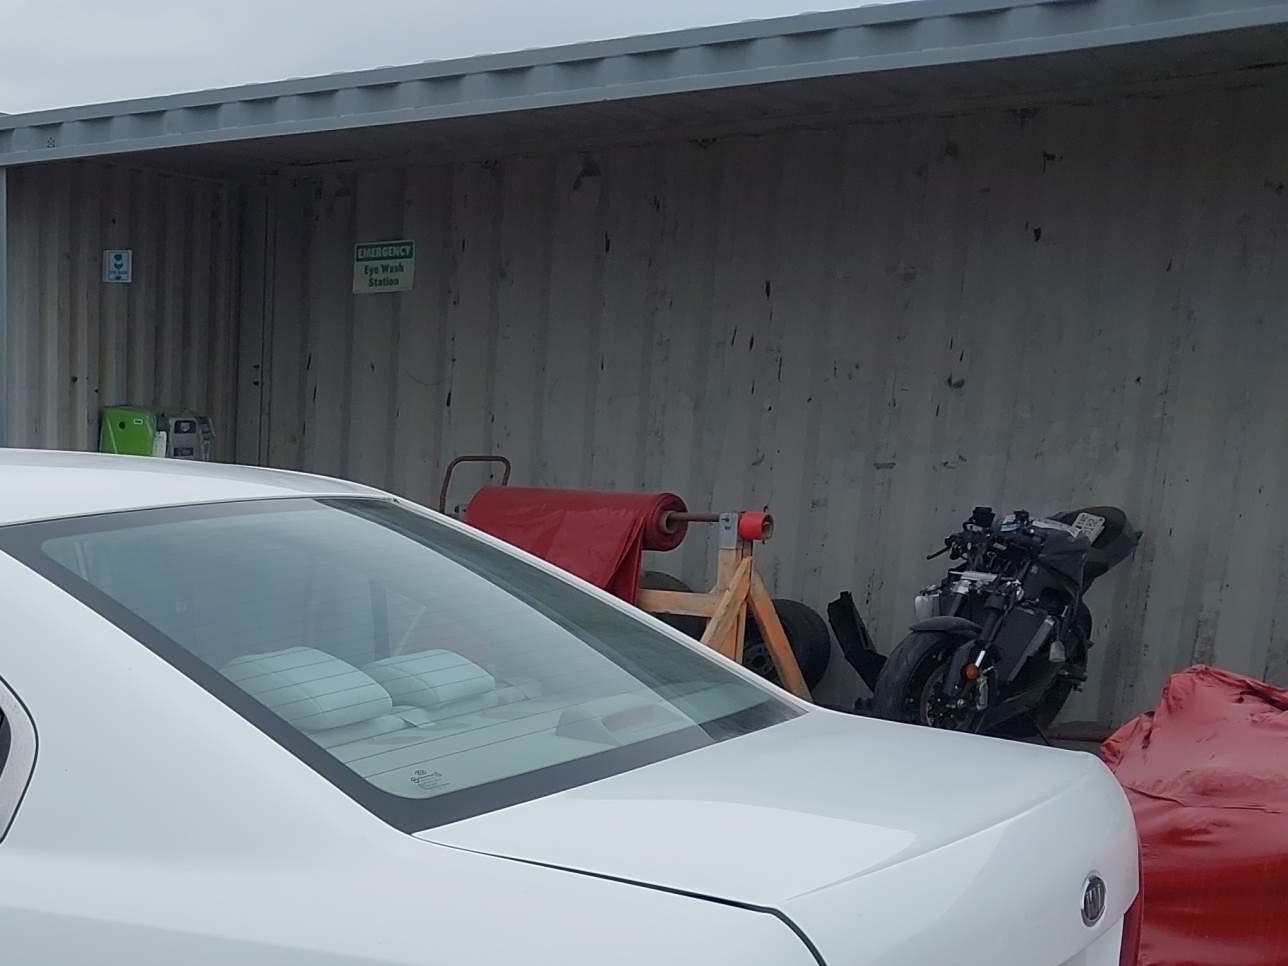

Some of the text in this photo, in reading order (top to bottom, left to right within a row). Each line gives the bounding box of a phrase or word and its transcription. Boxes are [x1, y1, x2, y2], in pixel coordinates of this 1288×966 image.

[358, 245, 411, 258] EMERGENCY
[364, 262, 404, 277] Eye Wash
[368, 277, 399, 287] Station
